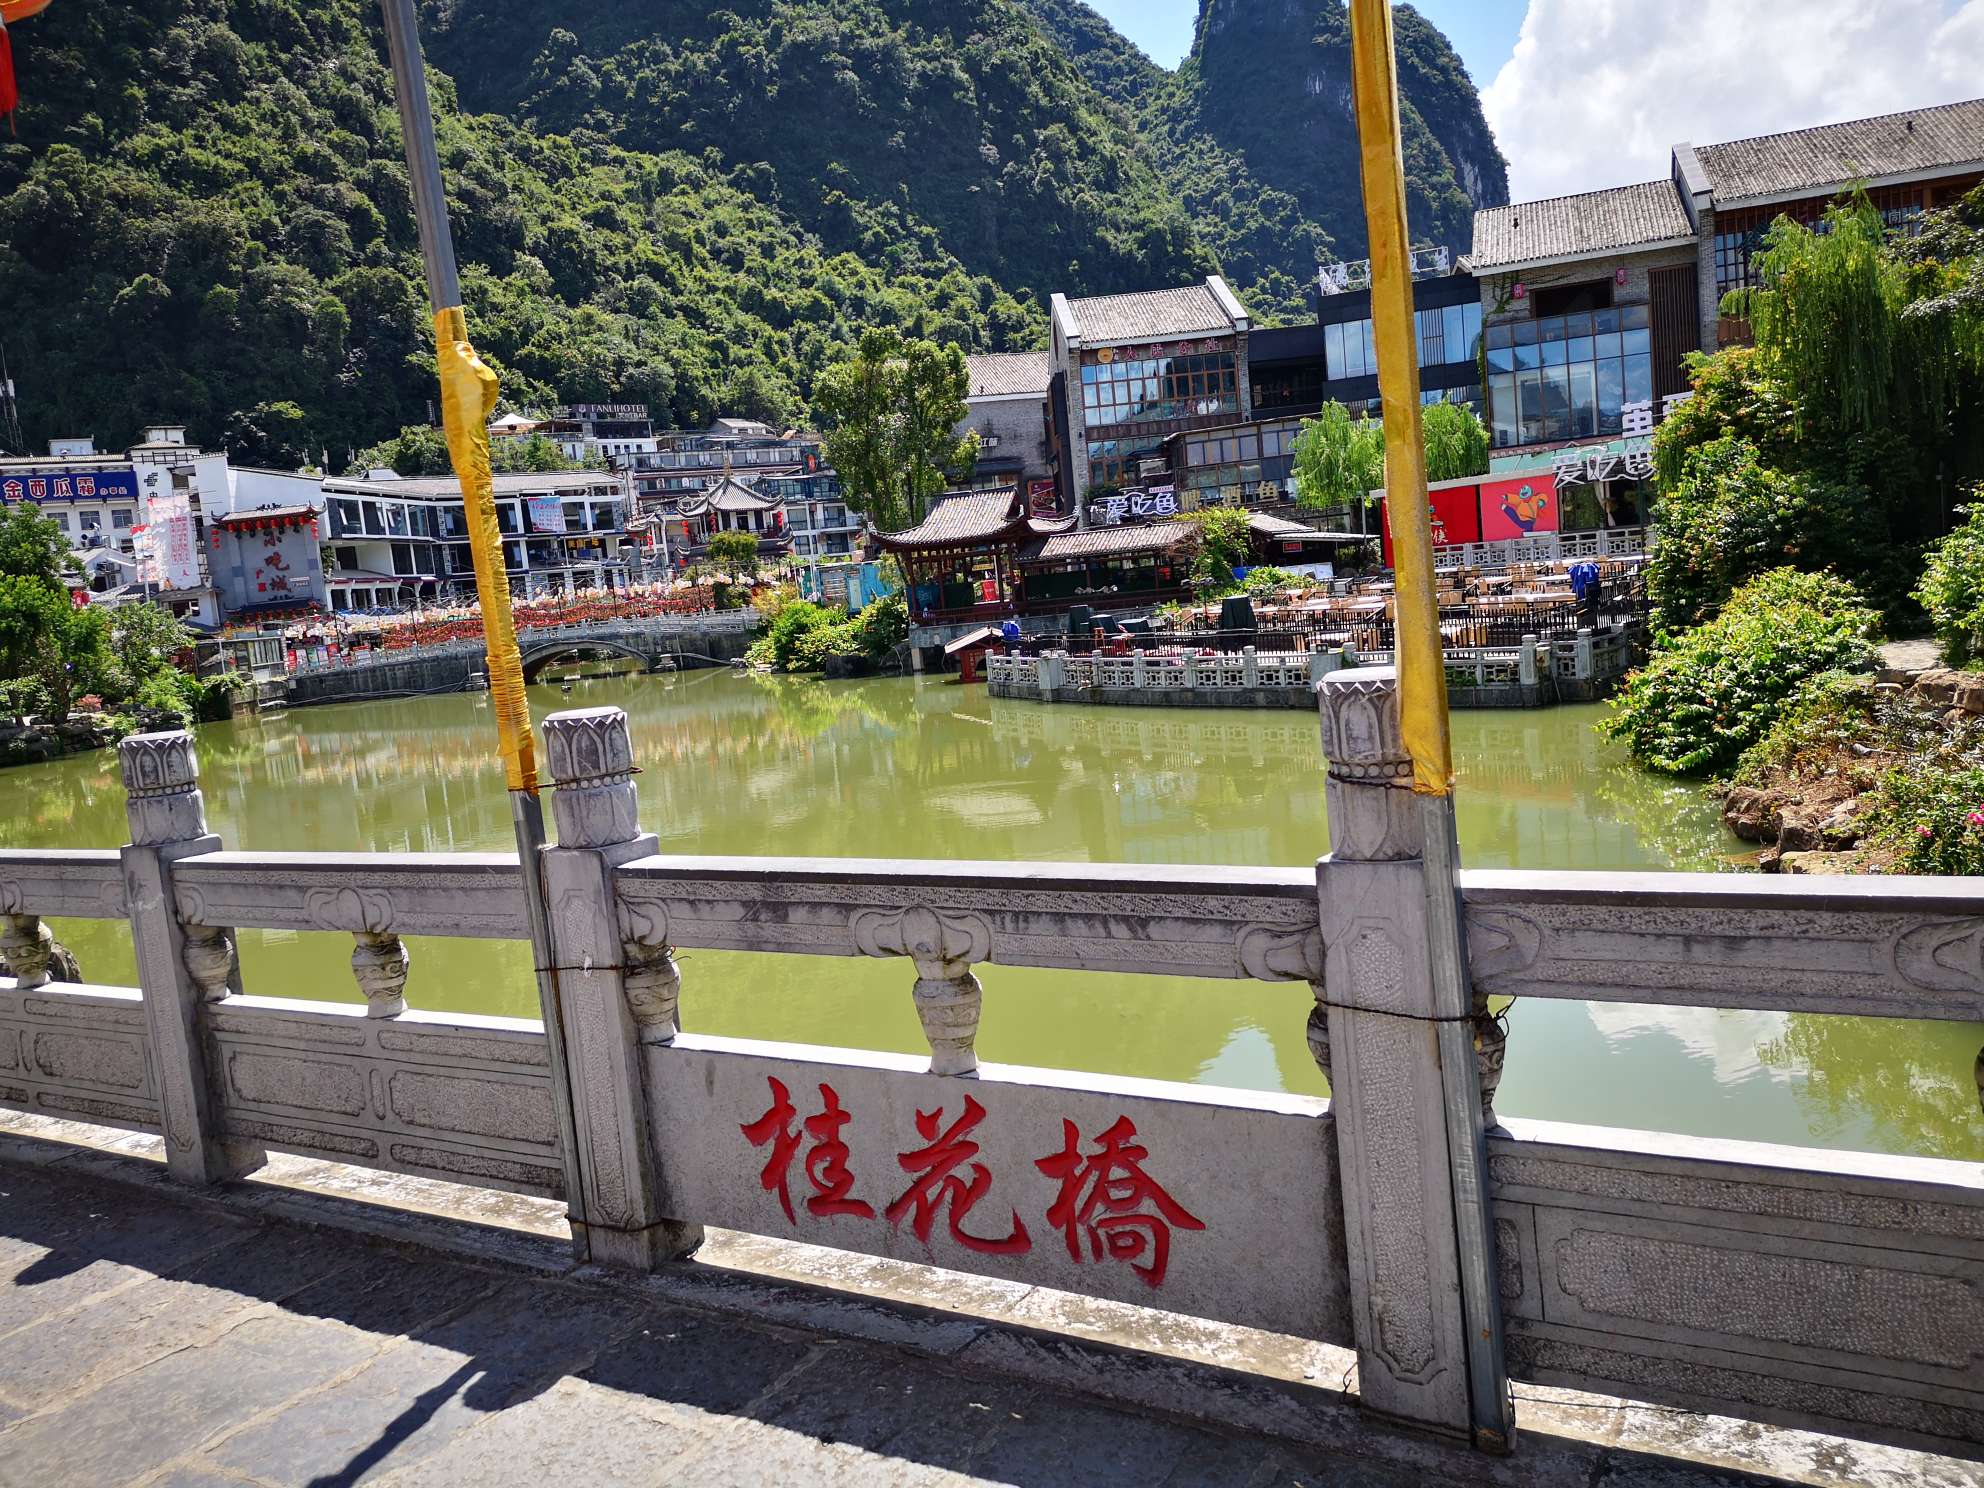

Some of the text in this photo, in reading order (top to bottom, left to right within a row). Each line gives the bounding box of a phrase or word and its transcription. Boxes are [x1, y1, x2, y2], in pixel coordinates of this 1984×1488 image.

[3, 476, 96, 500] 金西瓜霜
[740, 1075, 1206, 1287] 桂花橋
